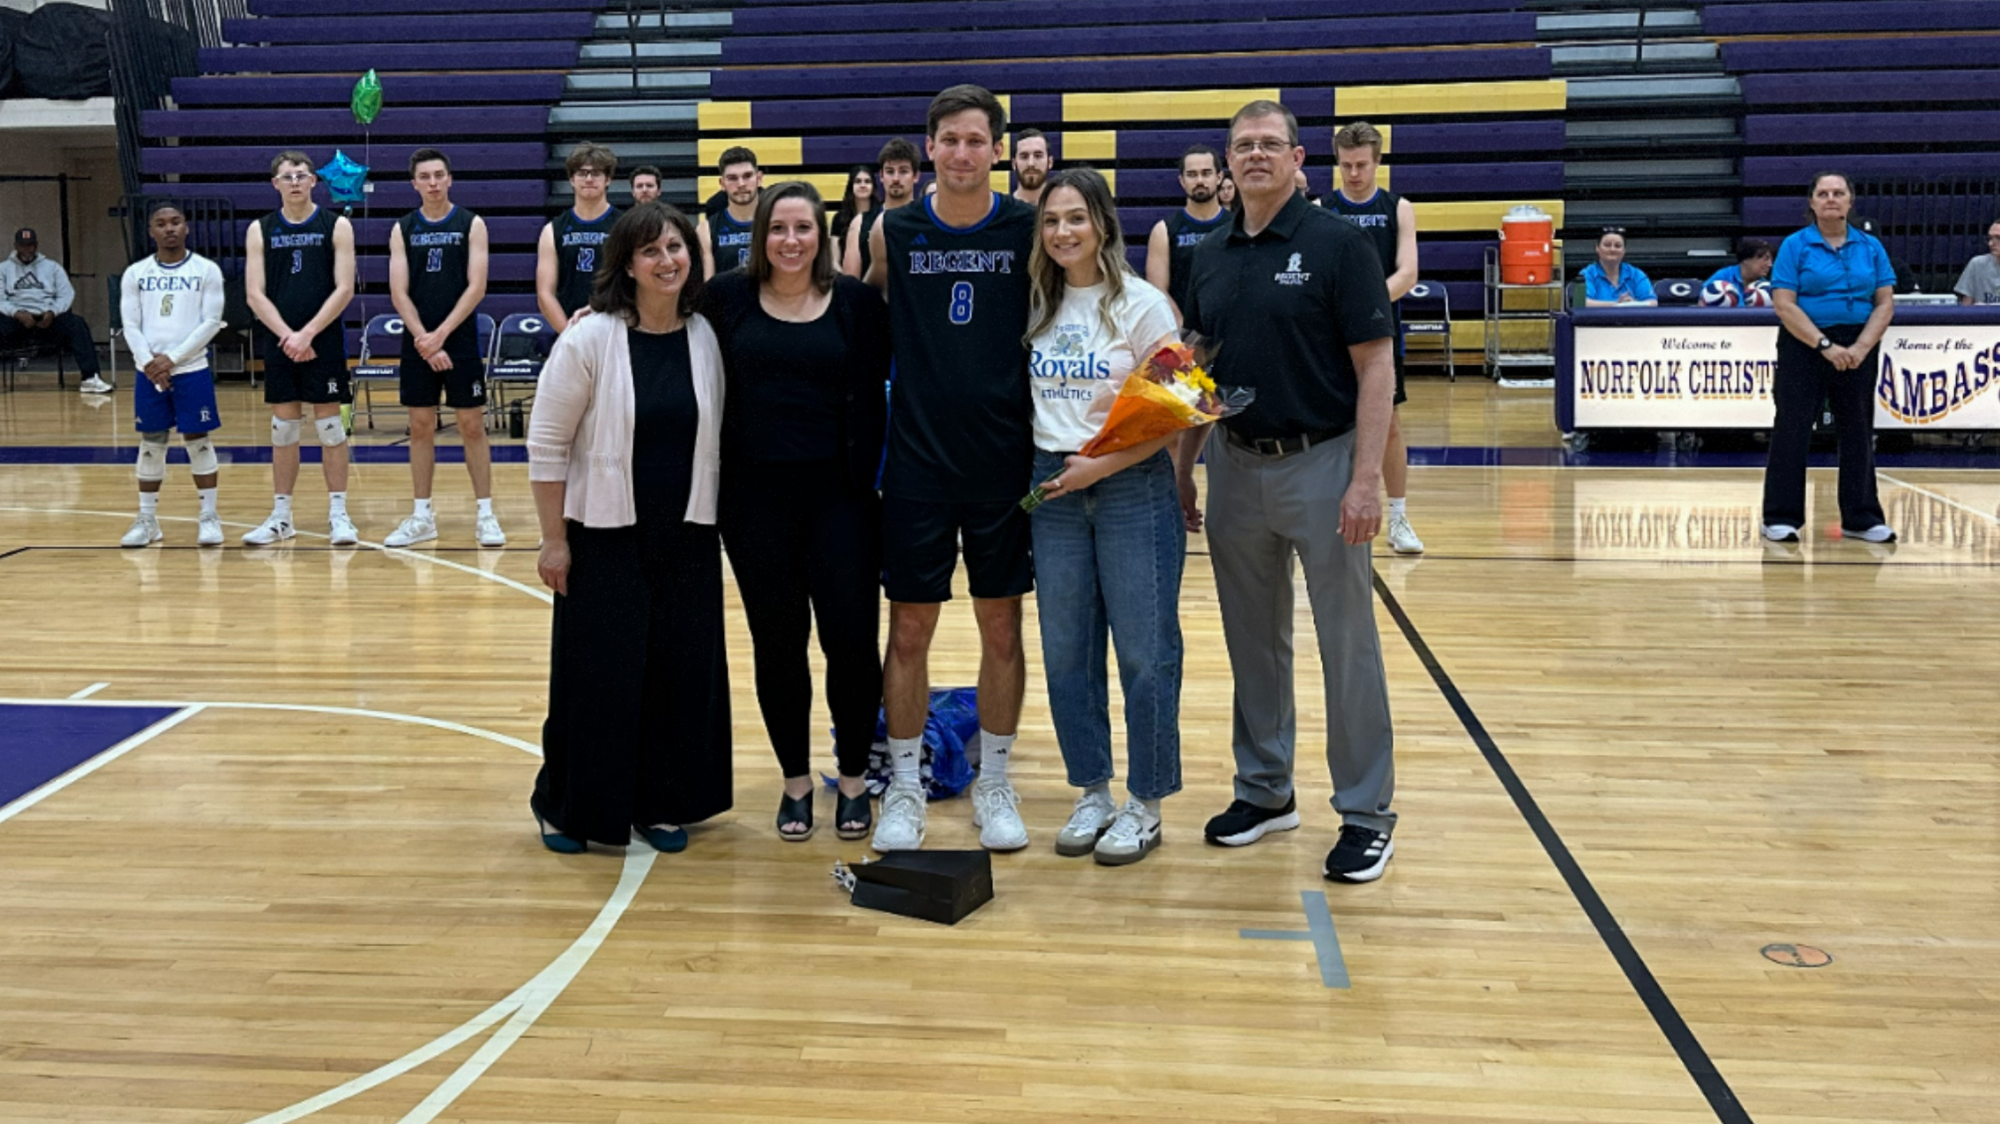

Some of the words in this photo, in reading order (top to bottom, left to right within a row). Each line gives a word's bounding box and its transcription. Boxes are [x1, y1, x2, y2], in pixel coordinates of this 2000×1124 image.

[576, 248, 595, 272] 12
[908, 250, 1014, 274] REGENT
[1670, 283, 1692, 296] C
[160, 294, 174, 317] 6
[949, 281, 974, 325] 8
[519, 318, 543, 333] C
[1661, 337, 1716, 350] Welcome
[1720, 339, 1732, 350] to
[1893, 338, 1933, 350] Home
[1936, 338, 1950, 353] of
[1953, 338, 1974, 350] the
[1029, 350, 1110, 387] Royals
[328, 381, 339, 394] R
[1580, 360, 1682, 399] NORFOLK
[1041, 388, 1093, 401] ATHLETICS
